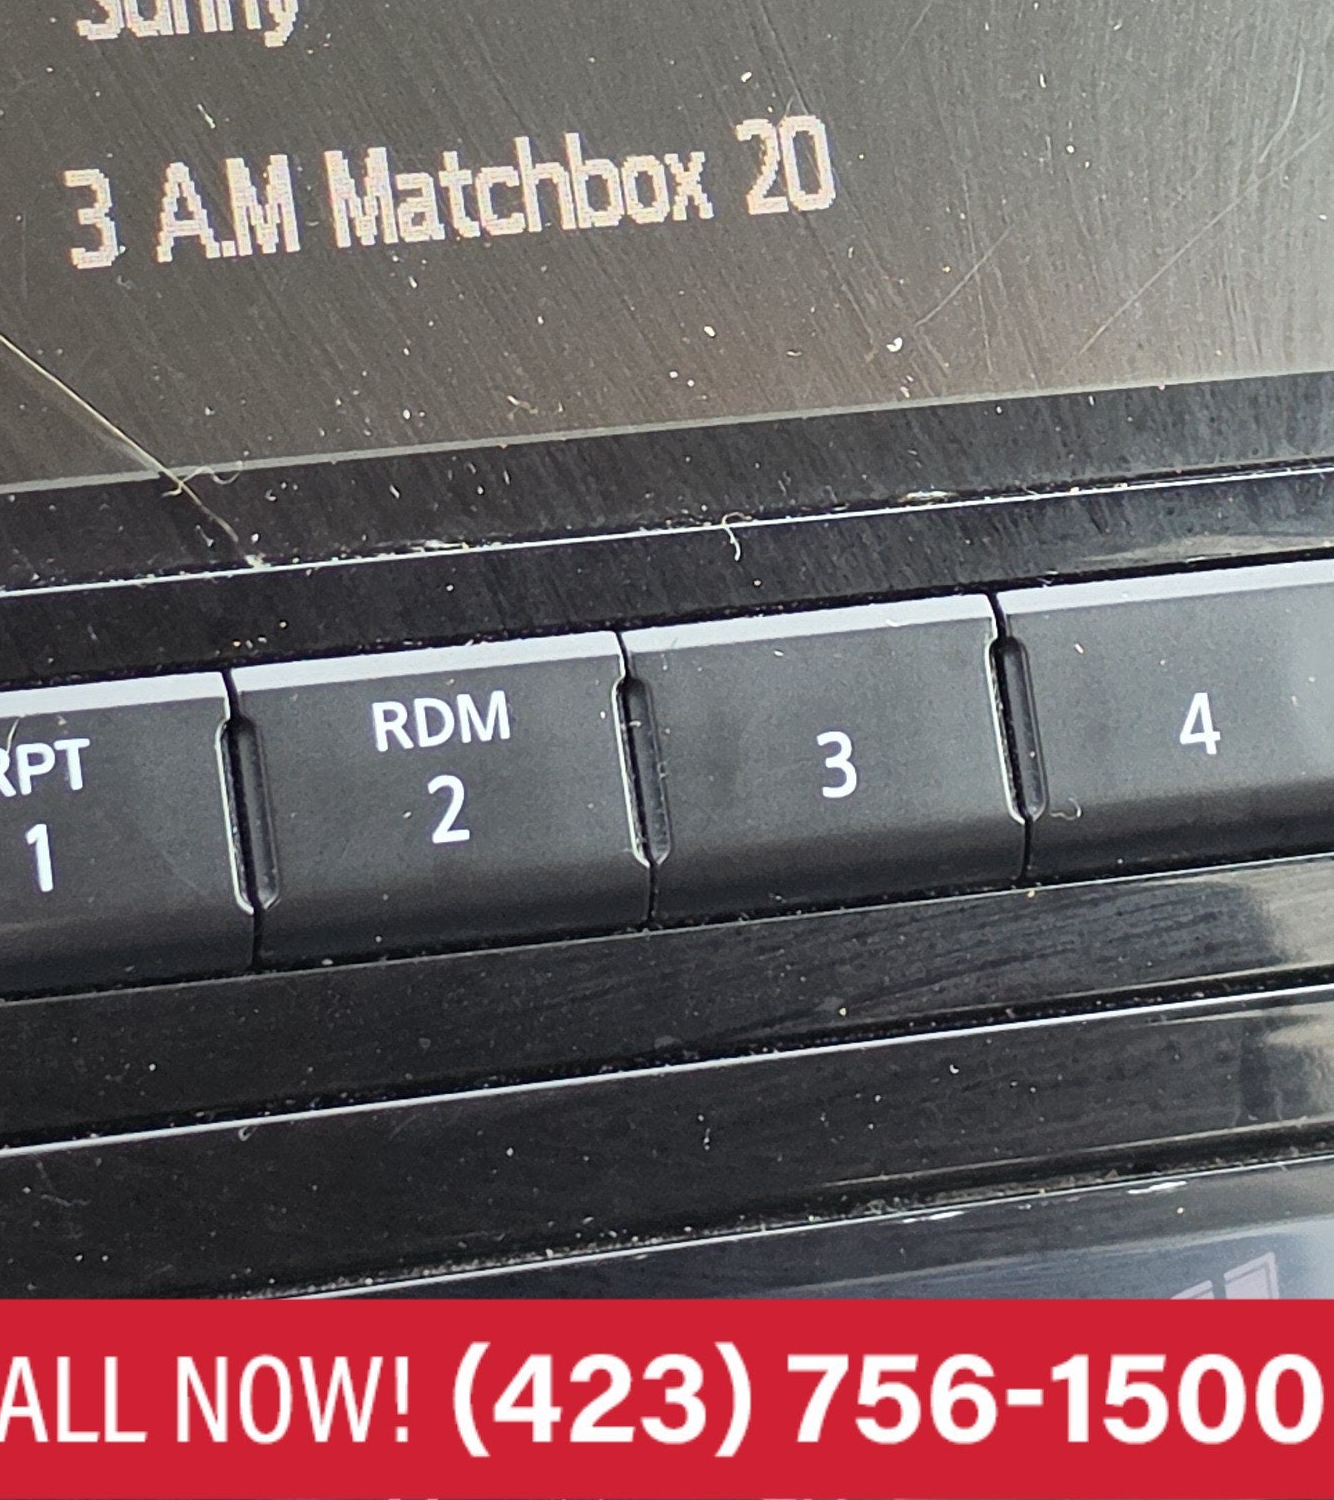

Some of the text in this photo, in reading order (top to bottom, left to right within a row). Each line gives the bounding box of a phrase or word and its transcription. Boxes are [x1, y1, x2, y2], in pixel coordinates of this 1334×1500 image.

[65, 114, 836, 269] 3 A.M Matchbox 20
[371, 690, 512, 751] RDM
[1178, 692, 1221, 757] 4
[815, 731, 858, 799] 3
[428, 775, 470, 844] 2
[25, 824, 54, 892] 1
